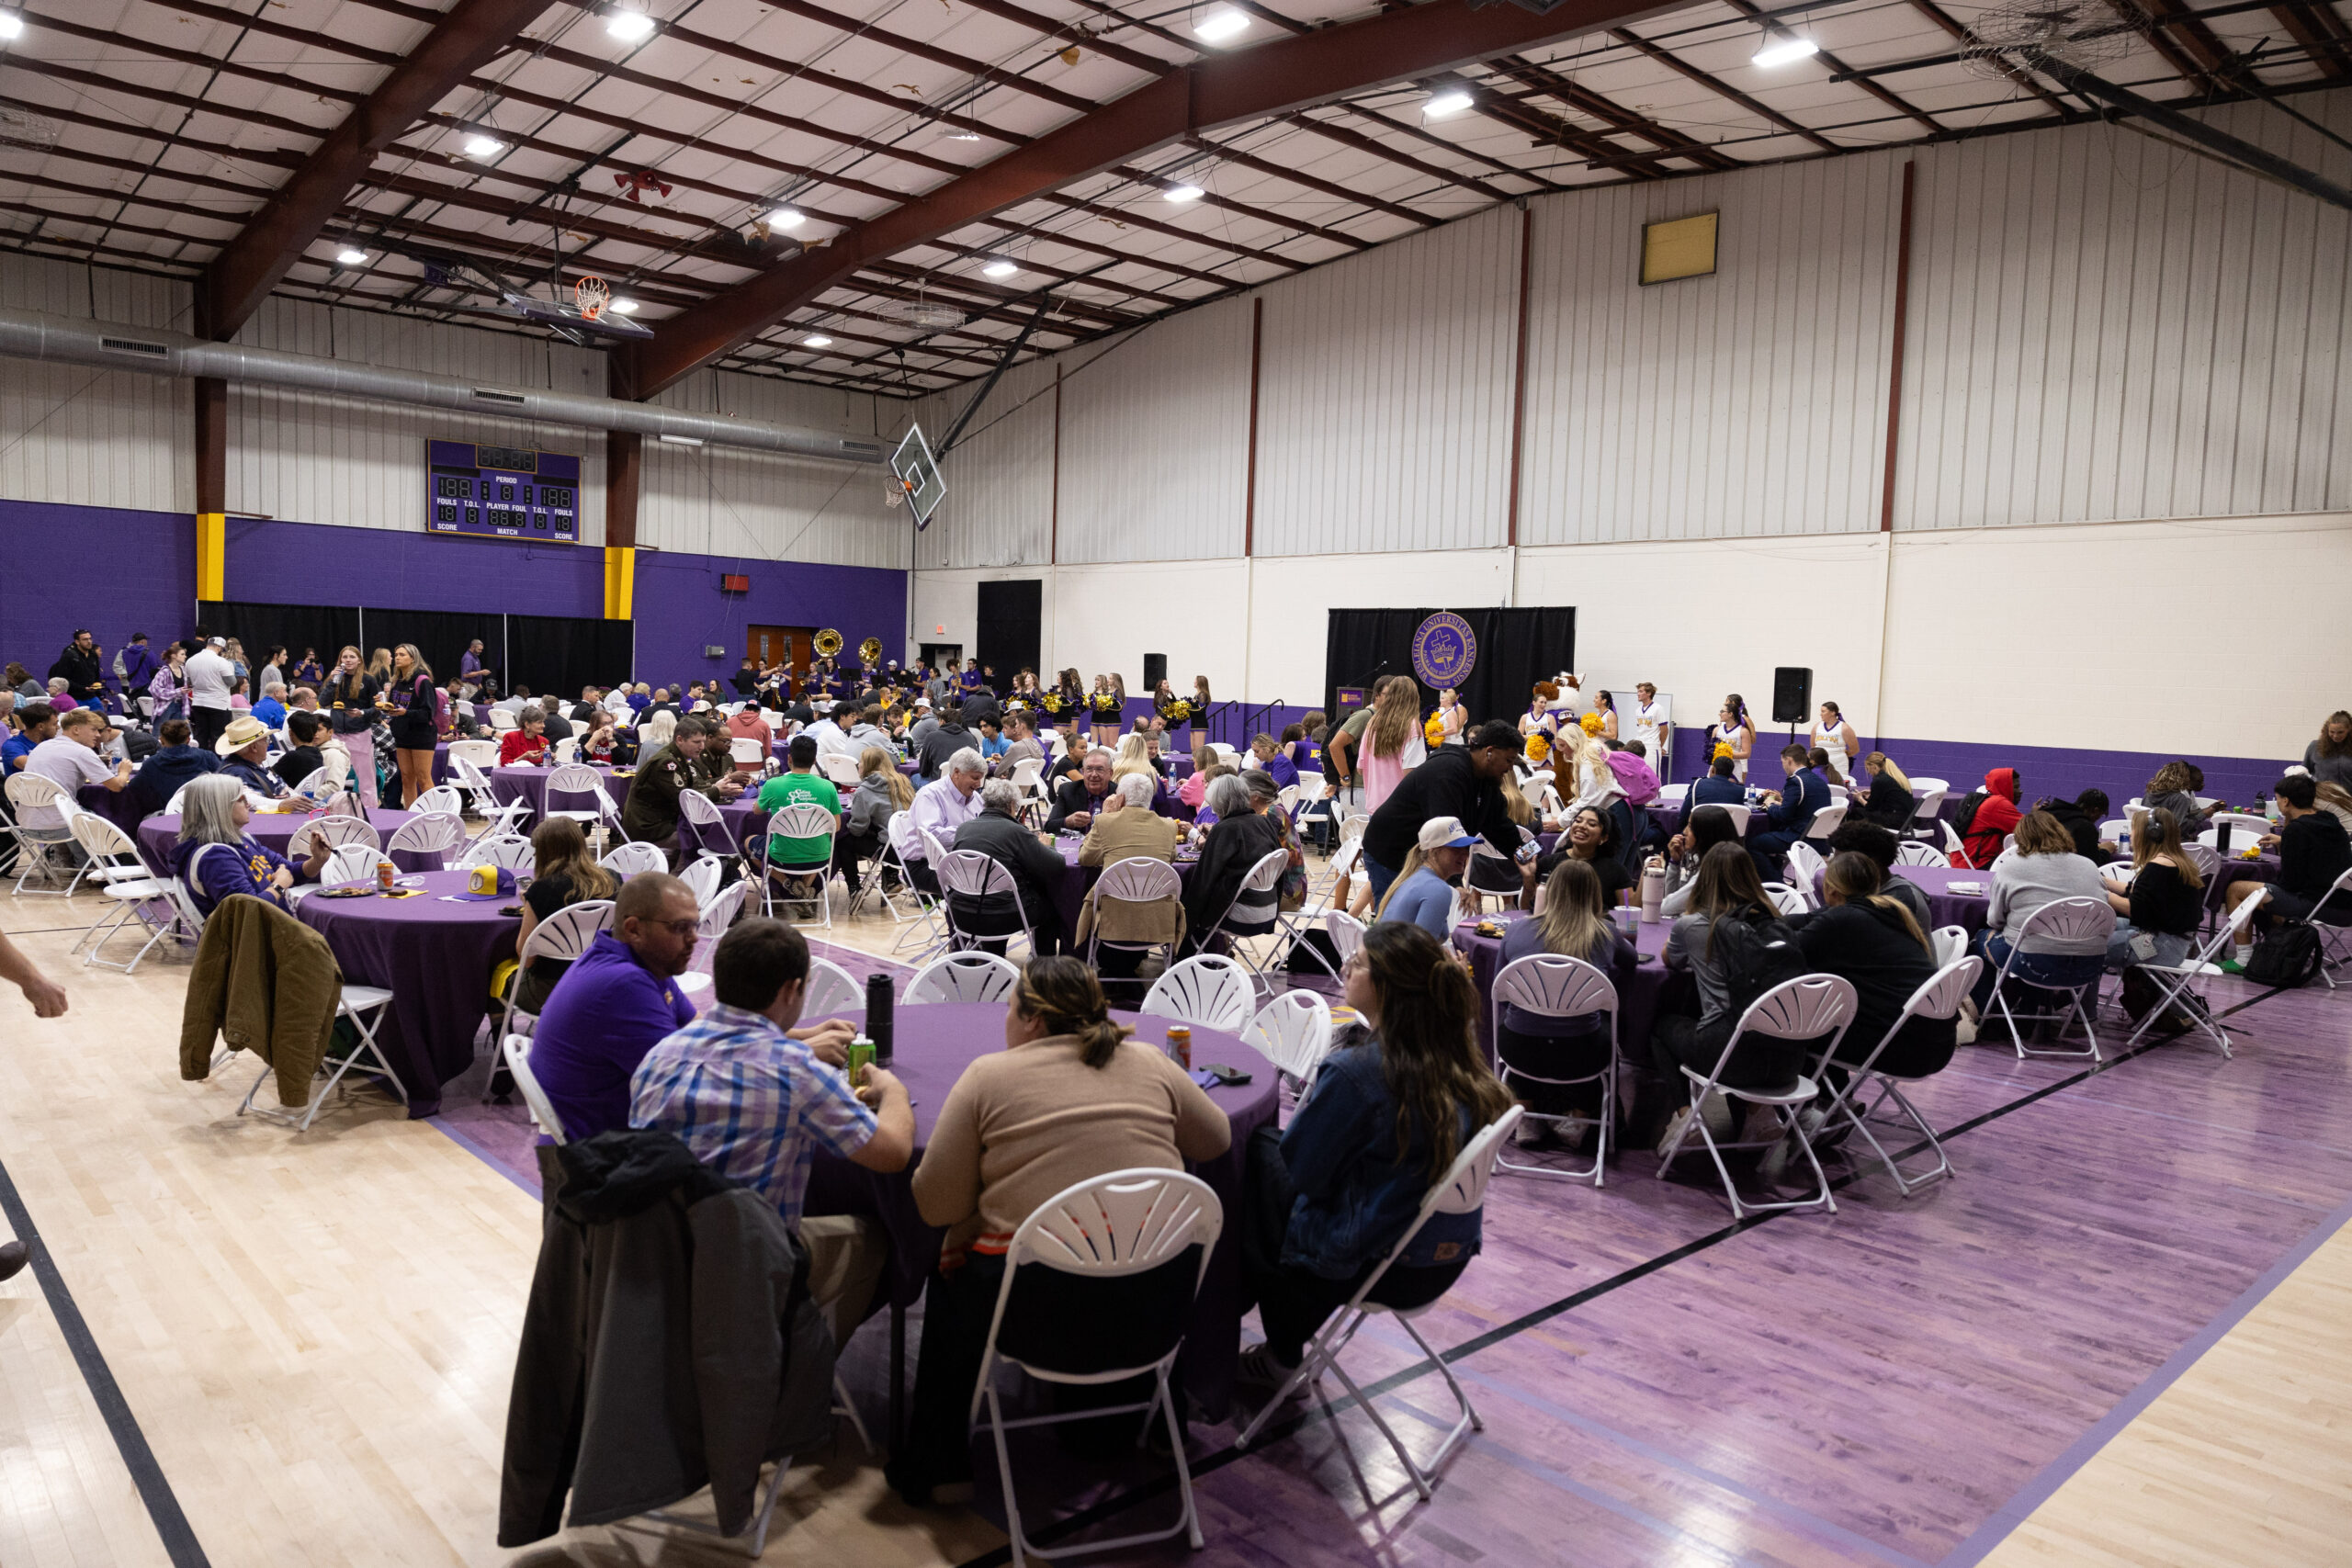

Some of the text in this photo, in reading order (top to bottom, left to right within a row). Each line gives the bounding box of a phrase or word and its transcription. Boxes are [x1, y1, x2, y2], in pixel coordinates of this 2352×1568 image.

[496, 476, 517, 484] PERIOD
[436, 498, 458, 506] FOULS
[463, 500, 481, 508] T.O.L.
[486, 502, 527, 513] PLAYER FOUL
[533, 506, 548, 514] T.O.L.
[554, 508, 573, 516] FOULS
[436, 523, 458, 531] SCORE
[496, 527, 518, 536] MATCH
[1413, 615, 1475, 685] WESLEIANA UNIVERSITAS KANSENSIS
